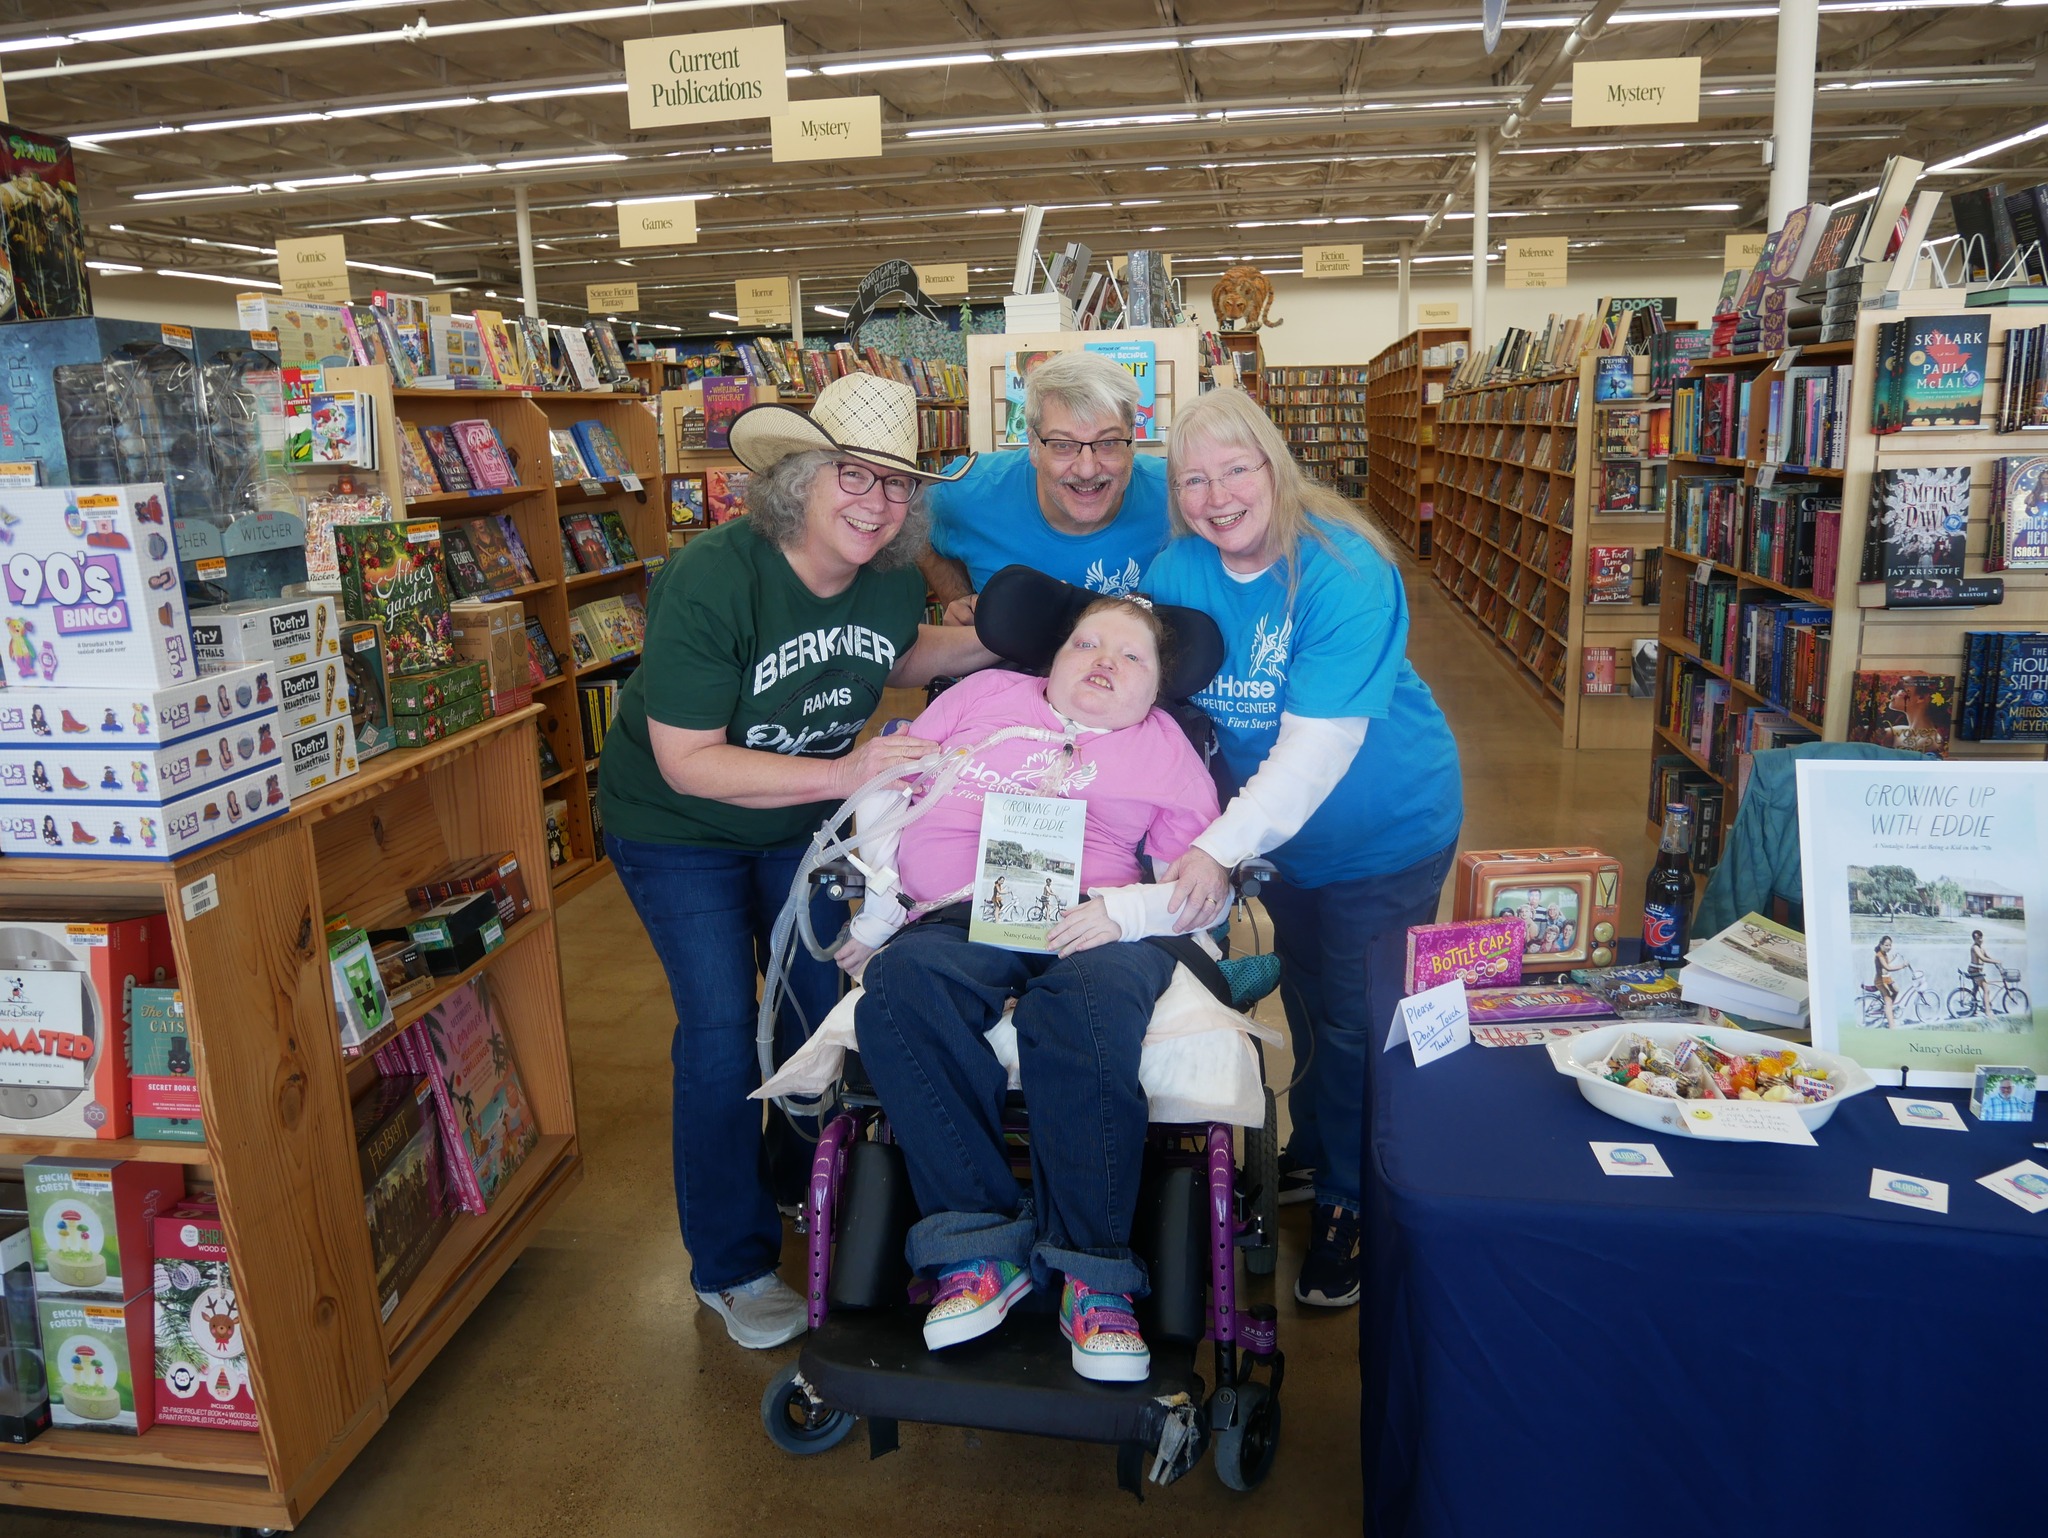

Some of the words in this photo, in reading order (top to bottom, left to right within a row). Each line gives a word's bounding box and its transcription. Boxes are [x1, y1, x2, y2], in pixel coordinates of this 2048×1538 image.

[669, 46, 741, 74] Current
[652, 77, 763, 108] Publications
[1607, 84, 1666, 107] Mystery
[801, 119, 851, 141] Mystery
[642, 217, 673, 231] Games
[297, 251, 327, 265] Comics
[1321, 251, 1345, 262] Fiction
[1519, 248, 1554, 259] Reference
[1315, 261, 1351, 272] Literature
[925, 274, 956, 284] Romance
[590, 288, 613, 298] Science
[614, 287, 635, 297] Fiction
[751, 287, 774, 298] Horror
[601, 298, 624, 309] Fantasy
[1914, 332, 1983, 346] SKYLARK
[1600, 357, 1629, 365] STEPHEN
[1922, 363, 1968, 375] PAULA
[1917, 378, 1967, 389] McLAI
[706, 393, 746, 402] WITCHCRAFT
[241, 523, 293, 542] WITCHER
[451, 551, 475, 566] FEARFUL
[1598, 549, 1610, 557] The
[1612, 549, 1629, 558] First
[312, 563, 336, 573] Little
[1603, 557, 1622, 567] Time
[309, 573, 335, 582] Sticker
[1609, 567, 1614, 575] I
[1888, 568, 1905, 577] JAY
[1909, 567, 1961, 576] KRISTOFF
[9, 551, 115, 606] 90's
[371, 558, 434, 599] Alice's
[1596, 575, 1612, 584] Saw
[1614, 572, 1630, 581] Him
[385, 585, 433, 634] garden
[63, 606, 123, 628] BINGO
[273, 613, 307, 633] Poetry
[1802, 616, 1831, 625] BLACK
[272, 631, 311, 649] NEANDERTHALS
[753, 624, 896, 697] BERKNER
[284, 674, 317, 695] Poetry
[1586, 683, 1613, 694] TENANT
[2010, 674, 2048, 691] SAPH
[283, 691, 321, 711] NEANDERTHALS
[803, 687, 852, 716] RAMS
[1239, 702, 1277, 714] CENTER
[2010, 706, 2048, 718] MARISS
[1227, 716, 1250, 729] First
[1250, 716, 1278, 730] Steps
[294, 736, 327, 757] Poetry
[294, 753, 331, 774] NEANDERTHALS
[1865, 783, 1960, 808] GROWING
[1969, 785, 1997, 808] UP
[1002, 800, 1051, 815] GROWING
[1055, 803, 1071, 815] UP
[1003, 814, 1029, 828] WITH
[1033, 818, 1068, 833] EDDIE
[1872, 813, 1920, 836] WITH
[1929, 815, 1995, 838] EDDIE
[1928, 844, 1944, 852] Being
[1003, 931, 1023, 942] Nancy
[1022, 933, 1042, 942] Golden
[1432, 942, 1478, 975] BOTTLE
[1478, 930, 1513, 955] CAPS
[1635, 966, 1663, 982] Pie
[141, 1005, 163, 1018] The
[1406, 1000, 1435, 1024] Please
[1437, 1006, 1462, 1028] Touch
[1412, 1026, 1436, 1046] Don't
[1909, 1043, 1943, 1056] Nancy
[1944, 1044, 1983, 1056] Golden
[148, 1084, 173, 1092] SECRET
[173, 1084, 191, 1092] BOOK
[86, 1111, 105, 1122] 100
[1612, 1150, 1645, 1162] BLOOMS
[35, 1182, 69, 1194] FOREST
[50, 1318, 84, 1330] FOREST
[211, 1402, 235, 1410] INCLUDES:
